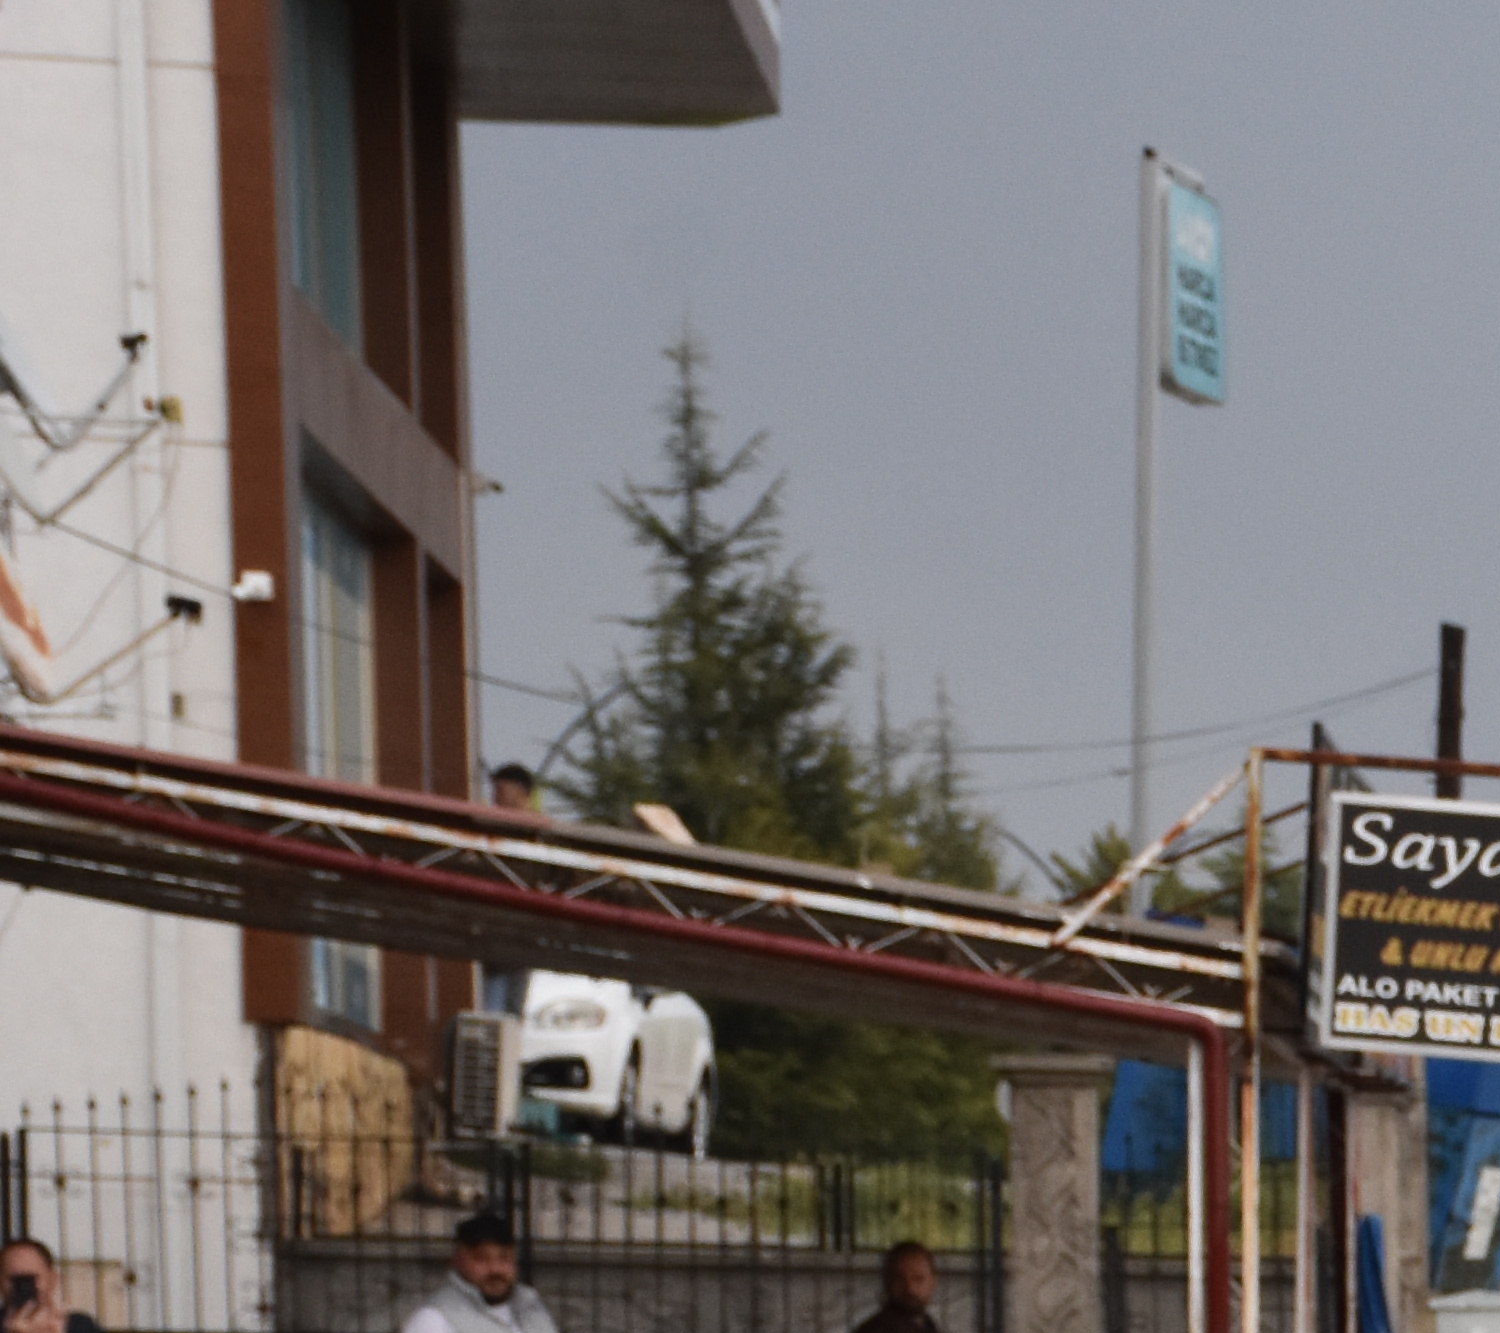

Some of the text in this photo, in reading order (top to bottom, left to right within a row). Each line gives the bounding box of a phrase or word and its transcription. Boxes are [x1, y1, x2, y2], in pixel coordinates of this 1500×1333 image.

[1379, 935, 1404, 967] &
[1409, 938, 1490, 974] UNLU
[1337, 973, 1399, 1000] ALO
[1405, 977, 1500, 1009] PAKET
[1333, 1000, 1421, 1039] HAS
[1423, 1008, 1485, 1045] UN
